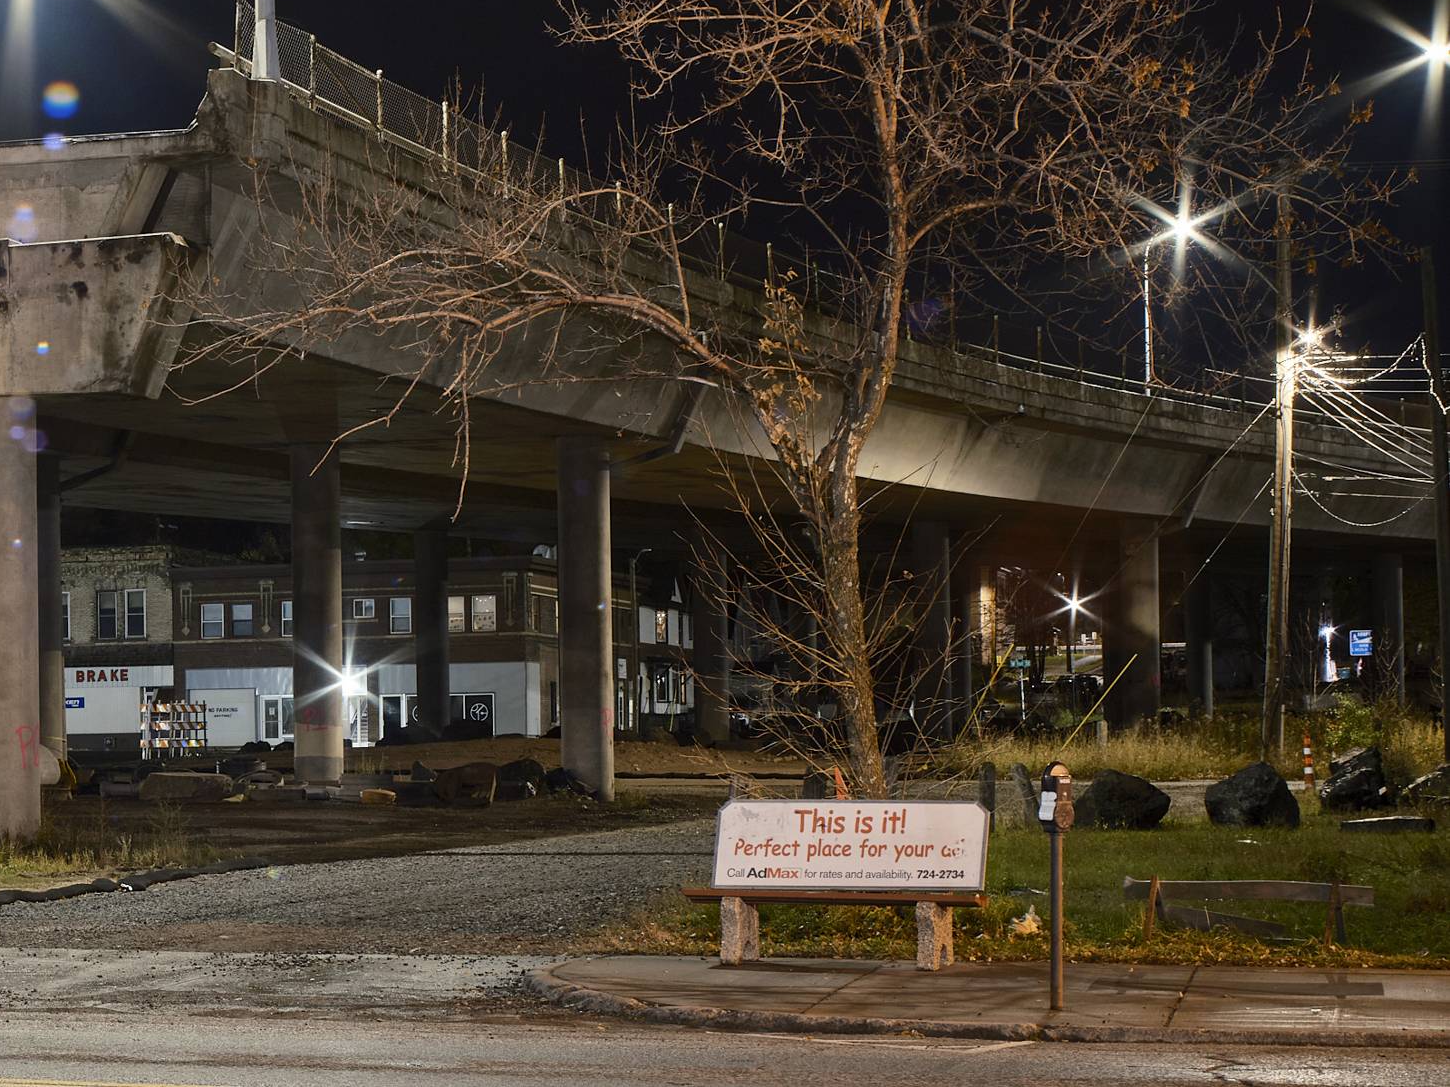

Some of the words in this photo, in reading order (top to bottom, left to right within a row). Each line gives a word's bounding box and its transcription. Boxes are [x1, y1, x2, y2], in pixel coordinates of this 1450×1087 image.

[76, 669, 129, 683] BRAKE
[795, 809, 845, 834] This
[854, 810, 873, 834] is
[882, 809, 906, 834] it!
[734, 838, 800, 857] Perfect
[807, 838, 852, 862] place
[859, 838, 887, 858] for
[895, 845, 934, 862] your
[727, 868, 745, 879] Call
[747, 867, 799, 879] AdMax
[804, 868, 817, 879] for
[819, 869, 843, 879] rates
[845, 868, 863, 879] and
[865, 868, 913, 881] availability.
[917, 869, 965, 880] 724-2734
